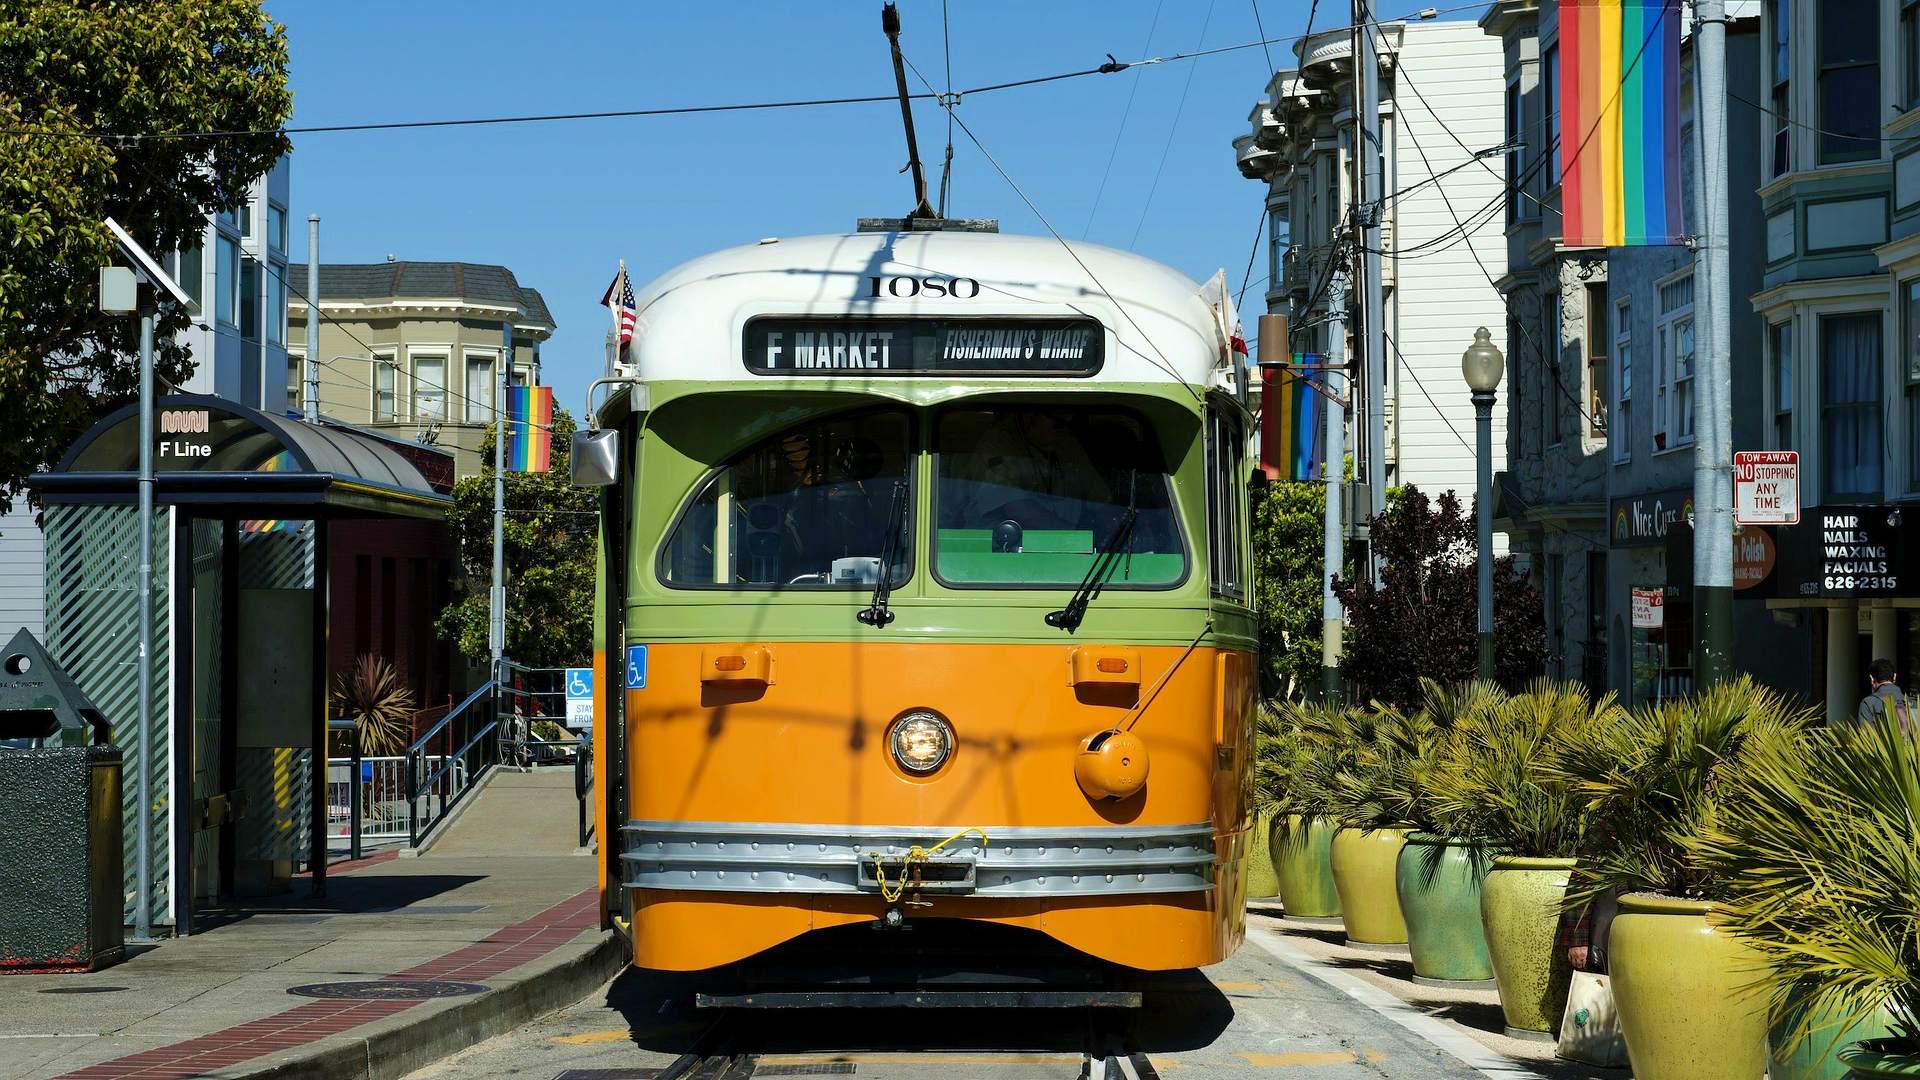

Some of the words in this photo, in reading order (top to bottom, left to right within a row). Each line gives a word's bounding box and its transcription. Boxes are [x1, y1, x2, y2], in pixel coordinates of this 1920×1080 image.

[866, 276, 980, 298] 1080
[767, 332, 783, 368] F
[795, 332, 893, 368] MARKET
[943, 329, 1036, 359] FISHERMAN'S
[1040, 329, 1090, 359] WHARF
[160, 441, 171, 457] F
[174, 441, 212, 457] Line
[1741, 453, 1792, 462] TOW-AWAY
[1737, 464, 1753, 480] NO
[1756, 467, 1795, 480] STOPPING
[1756, 483, 1778, 494] ANY
[1754, 497, 1780, 509] TIME
[1823, 515, 1859, 529] HAIR
[1824, 531, 1868, 543] NAILS
[1741, 535, 1765, 563] Polish
[1824, 546, 1887, 558] WAXING
[1824, 561, 1888, 574] FACIALS
[1824, 576, 1897, 590] 626-2315
[576, 704, 593, 713] STAY
